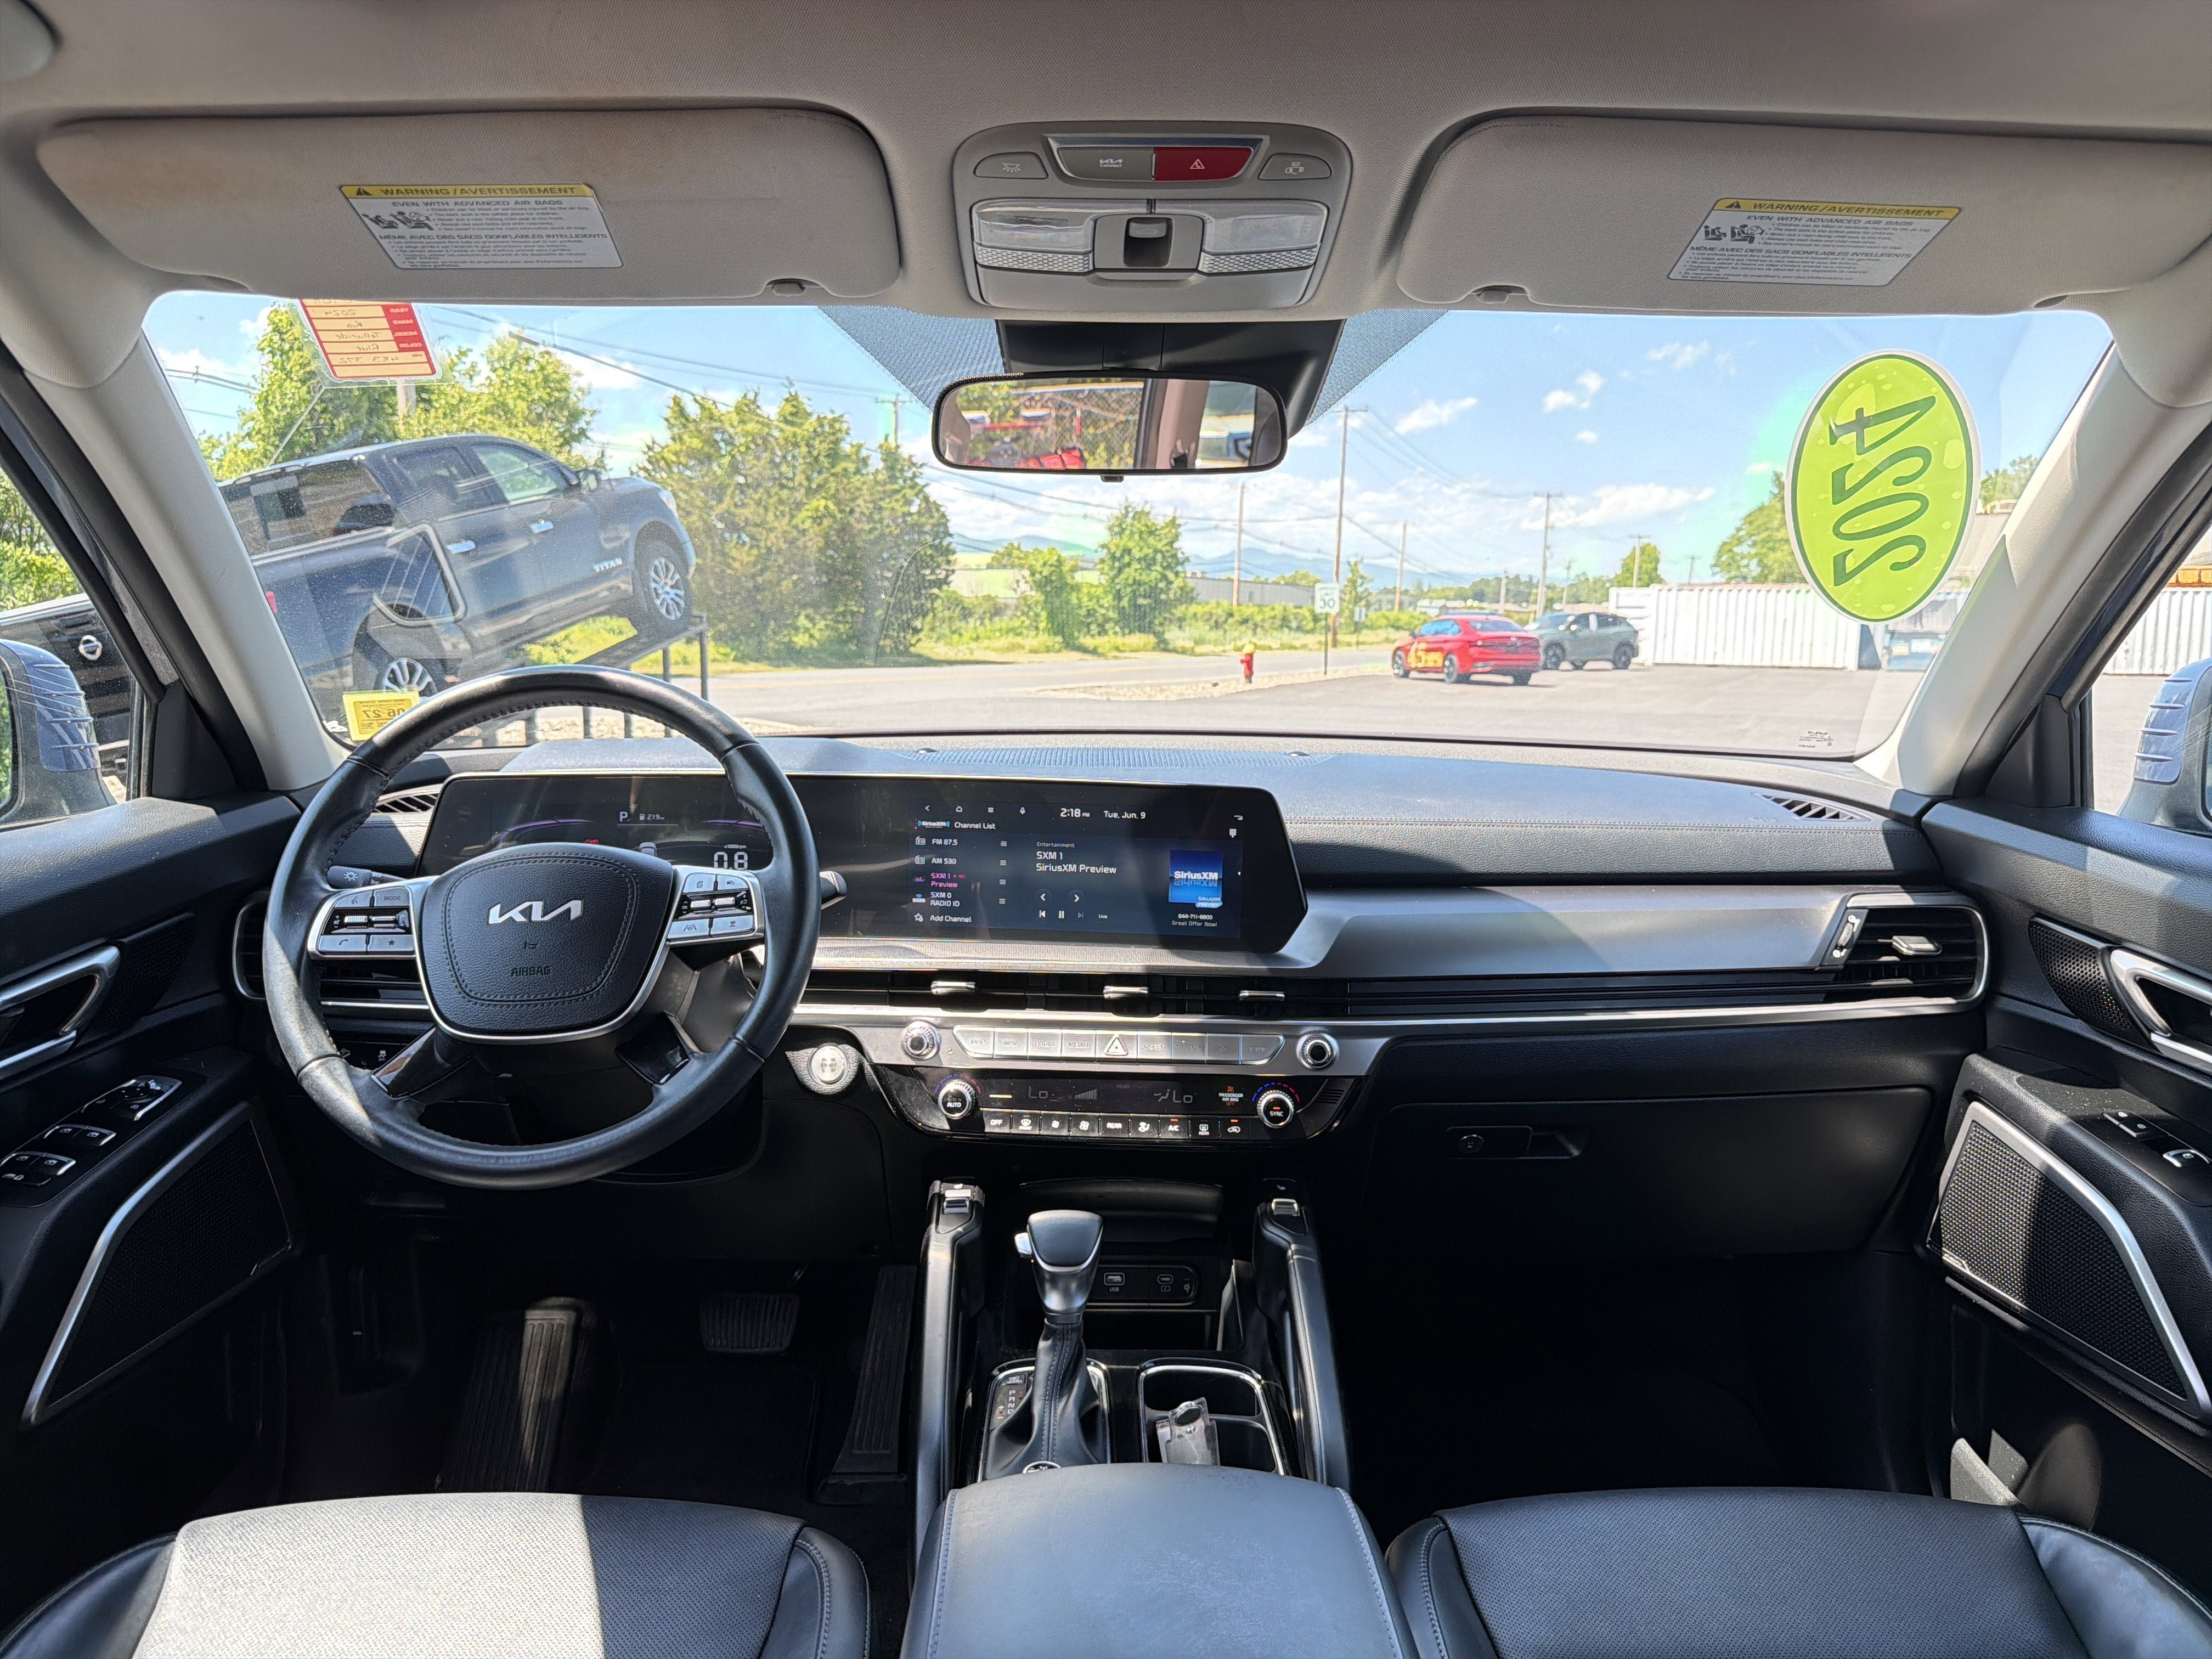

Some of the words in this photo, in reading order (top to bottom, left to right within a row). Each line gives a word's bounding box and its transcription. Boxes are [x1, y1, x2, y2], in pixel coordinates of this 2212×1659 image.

[1753, 203, 1816, 211] WARNING
[1826, 206, 1945, 217] AVERTISSEMENT
[1319, 598, 1335, 609] 30
[619, 811, 628, 822] P
[1060, 808, 1081, 817] 2:18
[1036, 851, 1057, 860] SXM
[1036, 863, 1076, 872] SiriusXM
[1079, 864, 1117, 873] Preview
[1174, 871, 1218, 881] SiriusXM
[511, 966, 552, 977] AIRBAG
